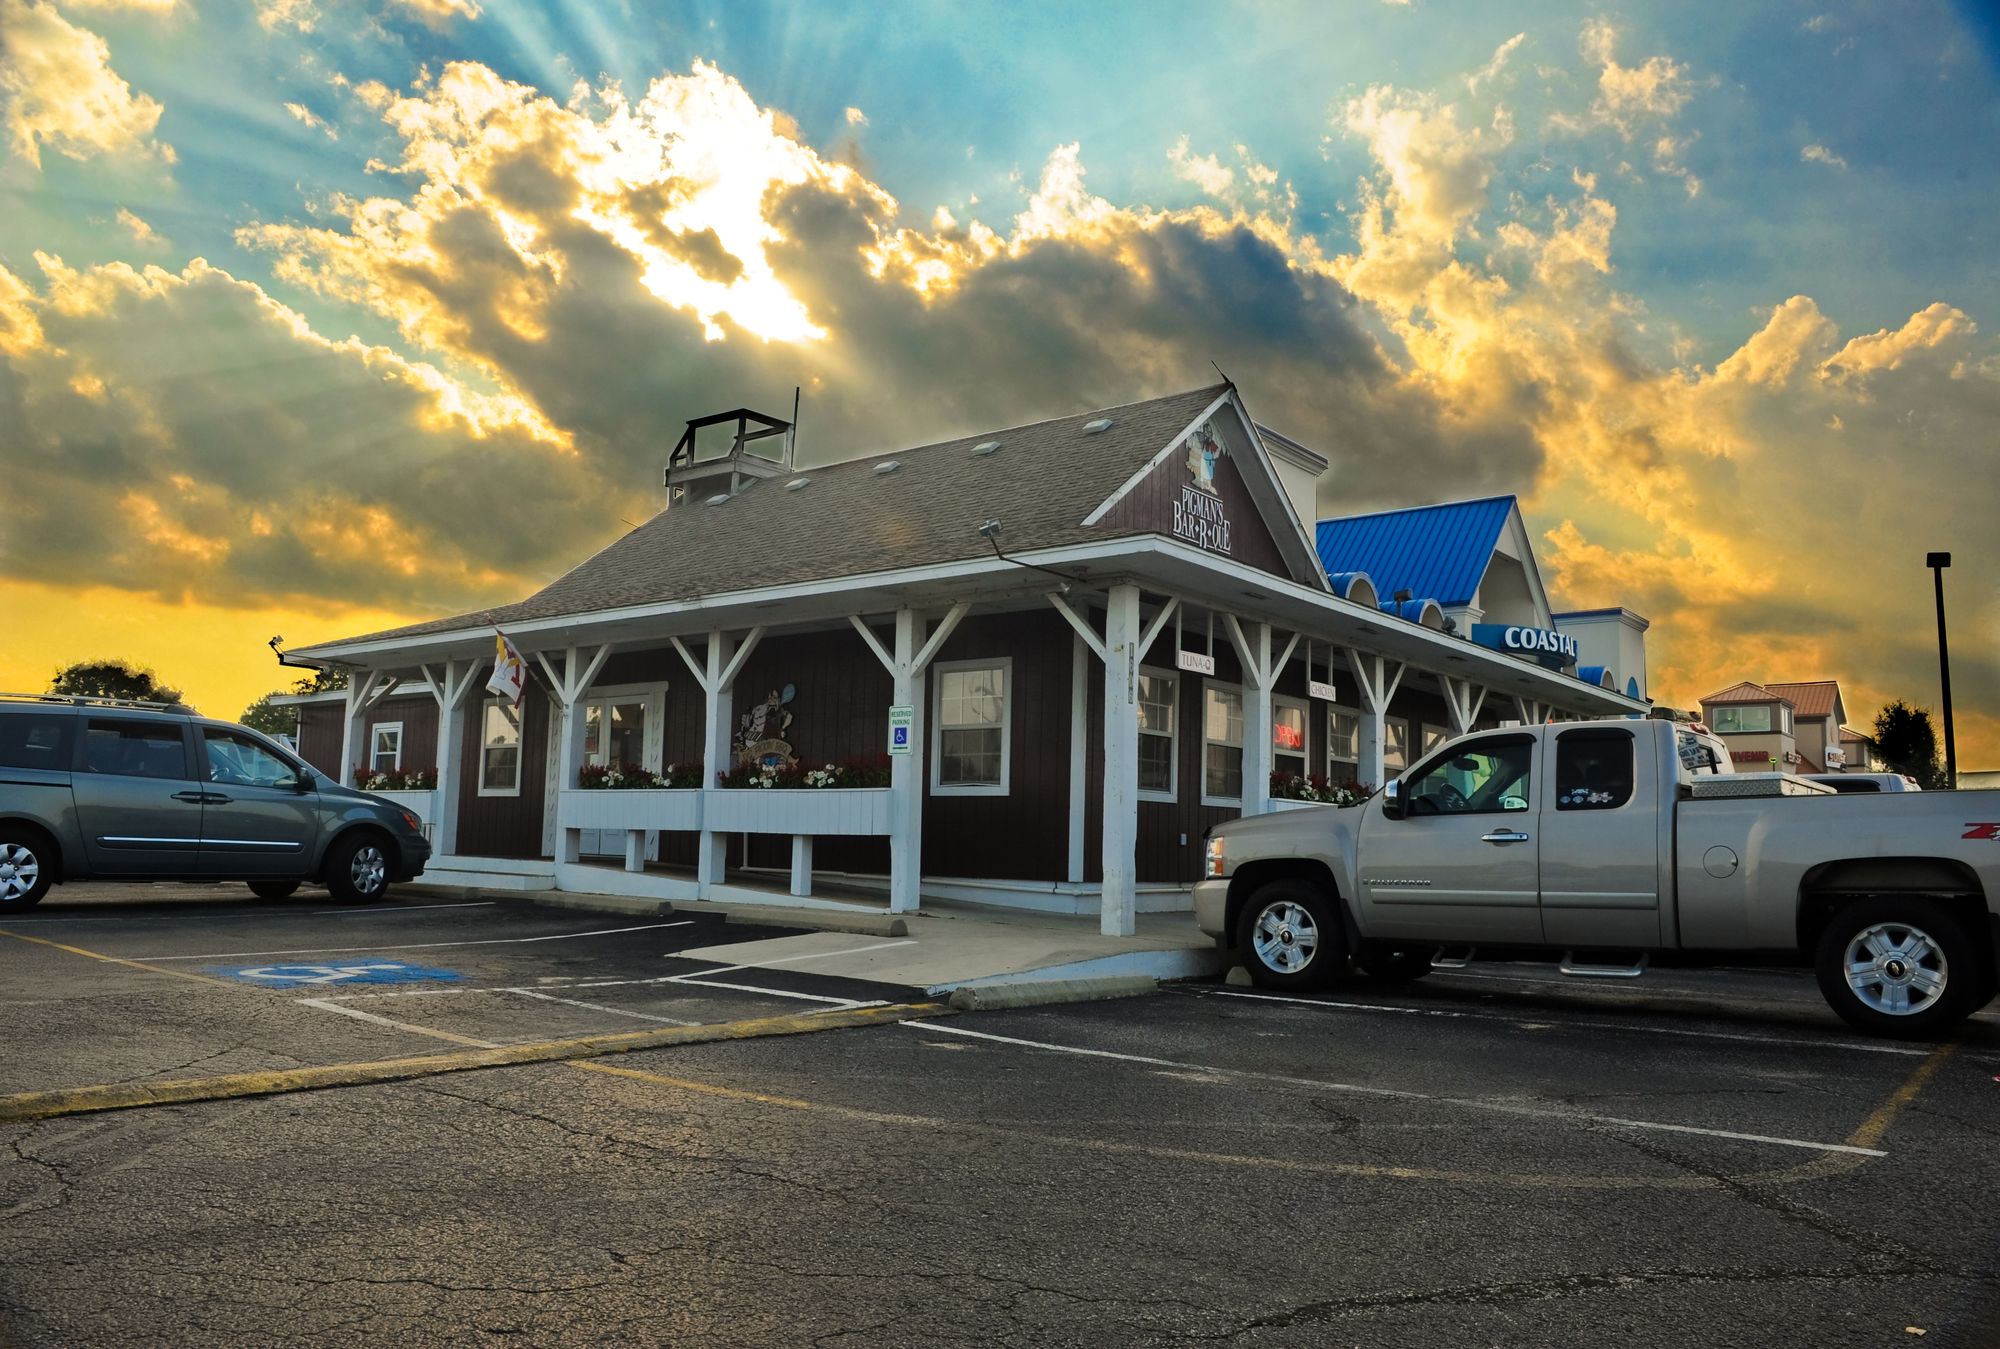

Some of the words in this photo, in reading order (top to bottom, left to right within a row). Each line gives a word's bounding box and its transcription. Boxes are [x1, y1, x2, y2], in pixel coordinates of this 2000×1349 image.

[1182, 488, 1223, 525] PIGMAN'S
[1505, 626, 1576, 657] COASTAL
[1182, 653, 1212, 671] TUNA-Q
[891, 710, 912, 718] RESERVED
[1961, 822, 2000, 840] Z
